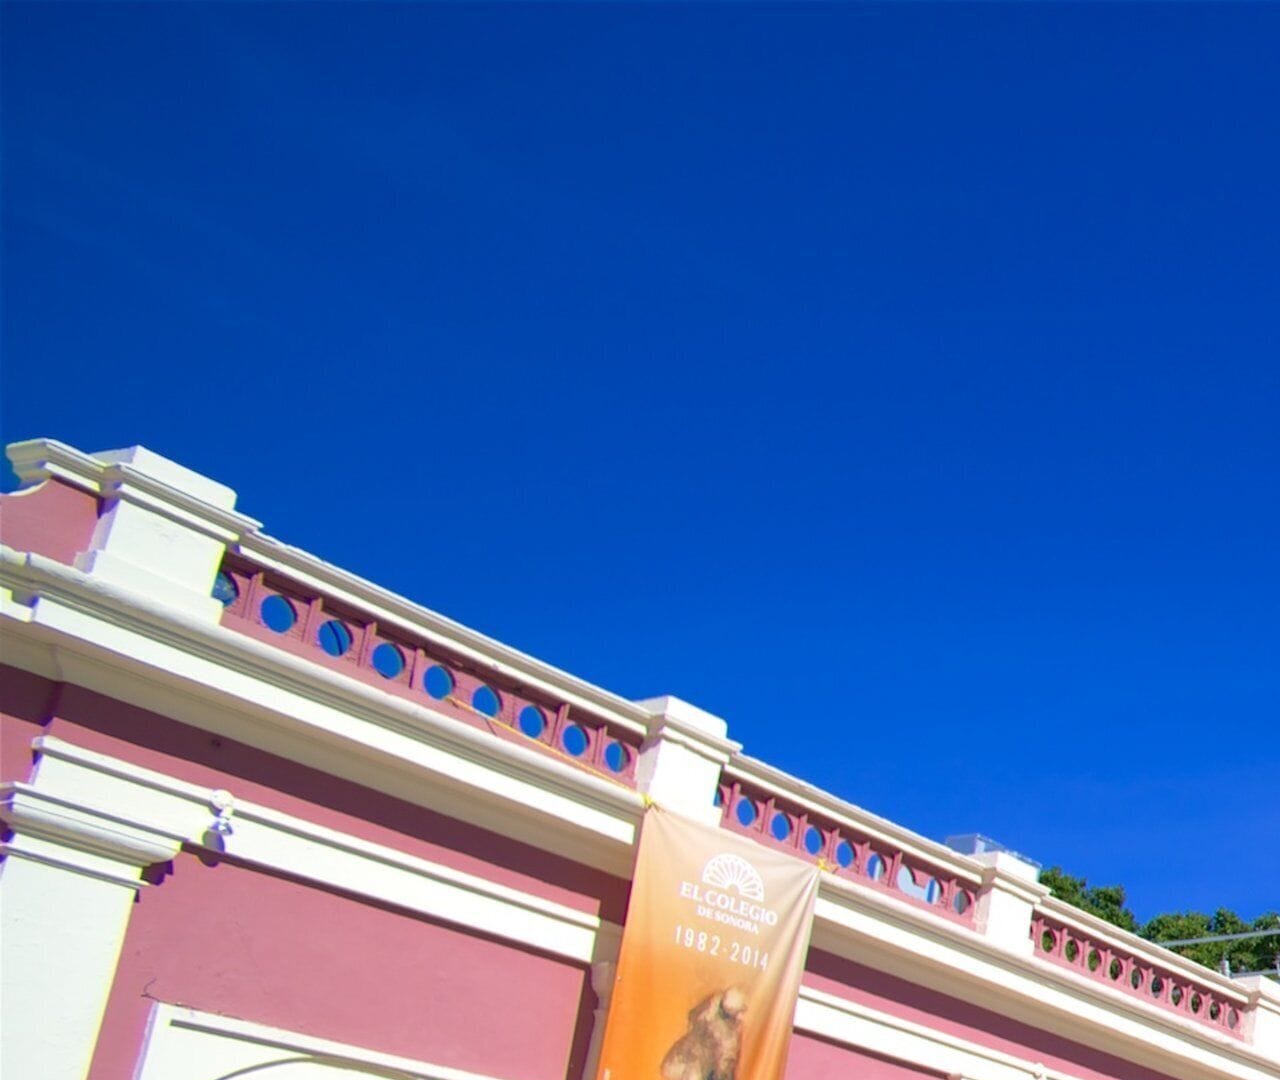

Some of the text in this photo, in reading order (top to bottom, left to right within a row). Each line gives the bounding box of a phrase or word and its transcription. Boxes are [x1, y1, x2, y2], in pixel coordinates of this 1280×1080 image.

[679, 880, 778, 926] EL COLEGIO
[695, 905, 760, 935] DE SONORA
